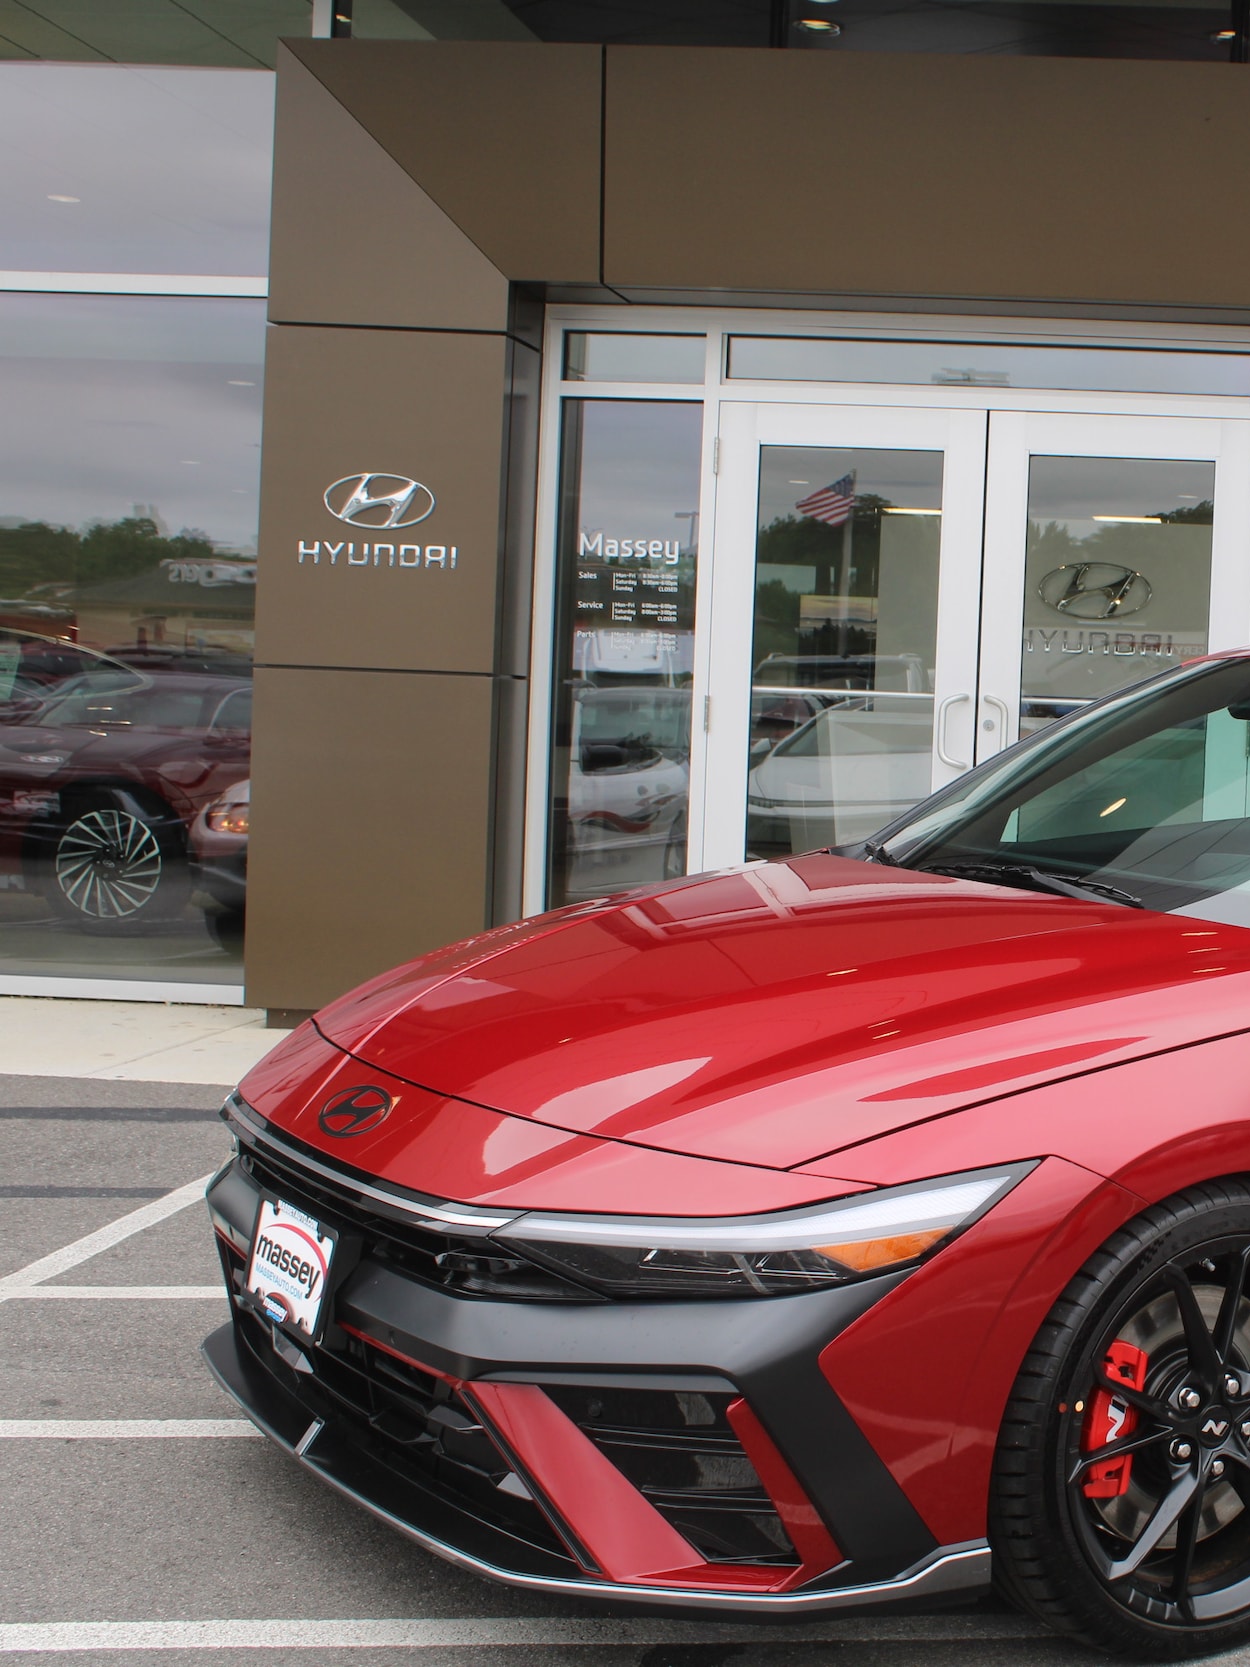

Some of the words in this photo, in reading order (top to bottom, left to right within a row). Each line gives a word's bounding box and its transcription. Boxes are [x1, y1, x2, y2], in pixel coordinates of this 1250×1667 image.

[298, 540, 458, 569] HYUNDAI
[580, 532, 680, 565] Massey
[578, 571, 597, 579] Sales
[577, 600, 604, 609] Service
[255, 1262, 304, 1301] MASSEYAUTO.COM
[256, 1234, 321, 1300] massey
[1201, 1419, 1229, 1437] N
